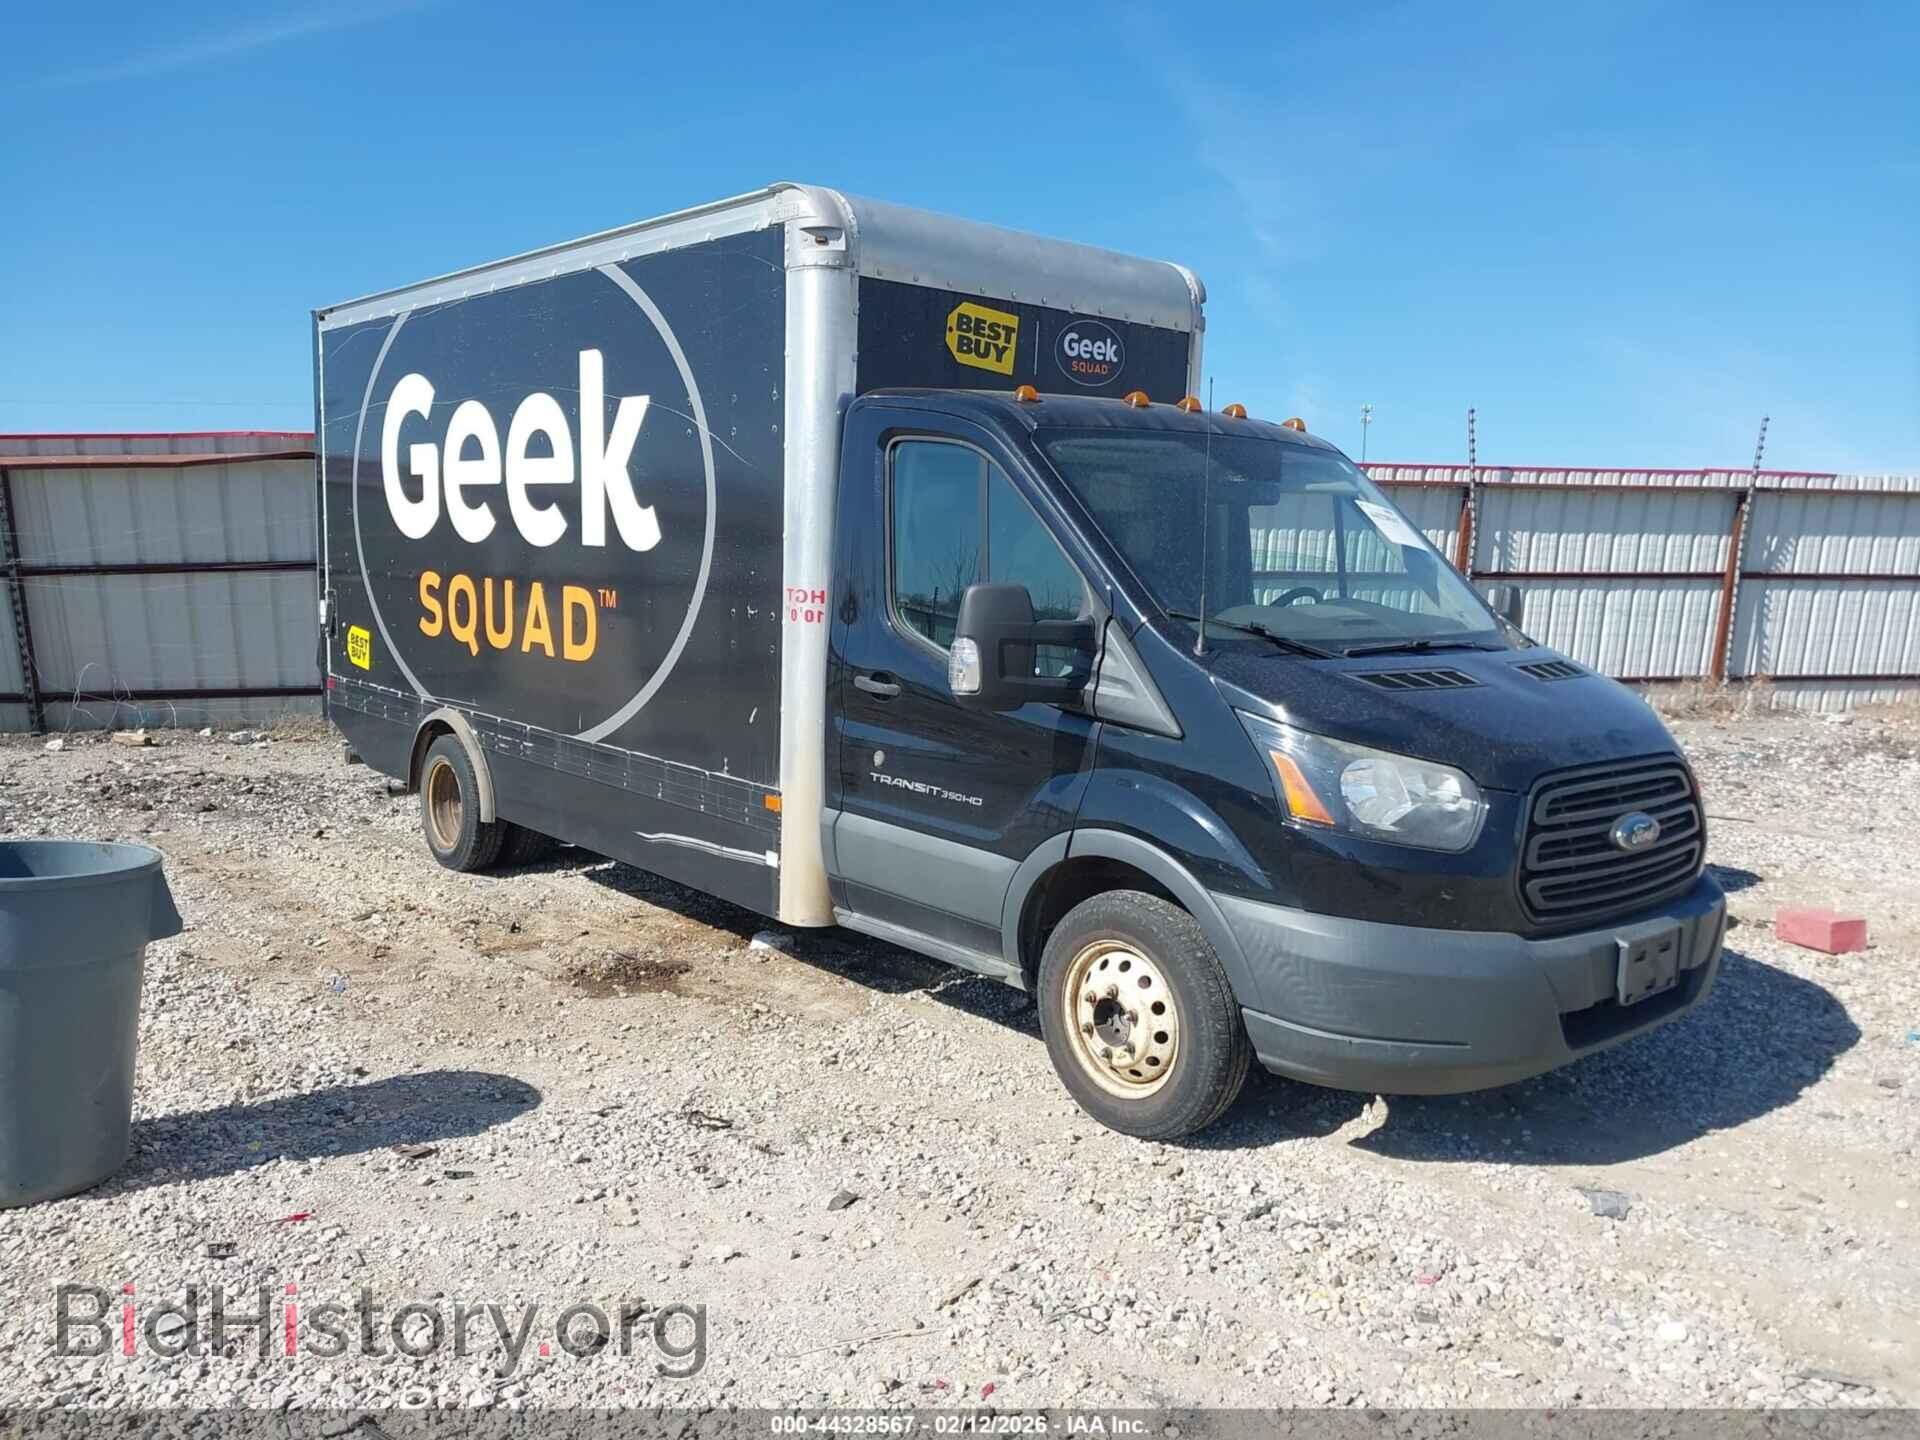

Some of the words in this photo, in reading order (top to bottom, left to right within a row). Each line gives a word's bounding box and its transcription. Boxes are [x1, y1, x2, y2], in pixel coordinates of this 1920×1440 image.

[956, 313, 1016, 346] BEST
[957, 336, 1009, 363] BUY
[1063, 332, 1118, 363] Geek
[1071, 360, 1109, 375] SQUAD
[381, 348, 662, 552] Geek
[418, 571, 597, 662] SQUAD
[350, 633, 368, 650] BEST
[351, 645, 367, 662] BUY
[869, 771, 942, 796] TRANSIT
